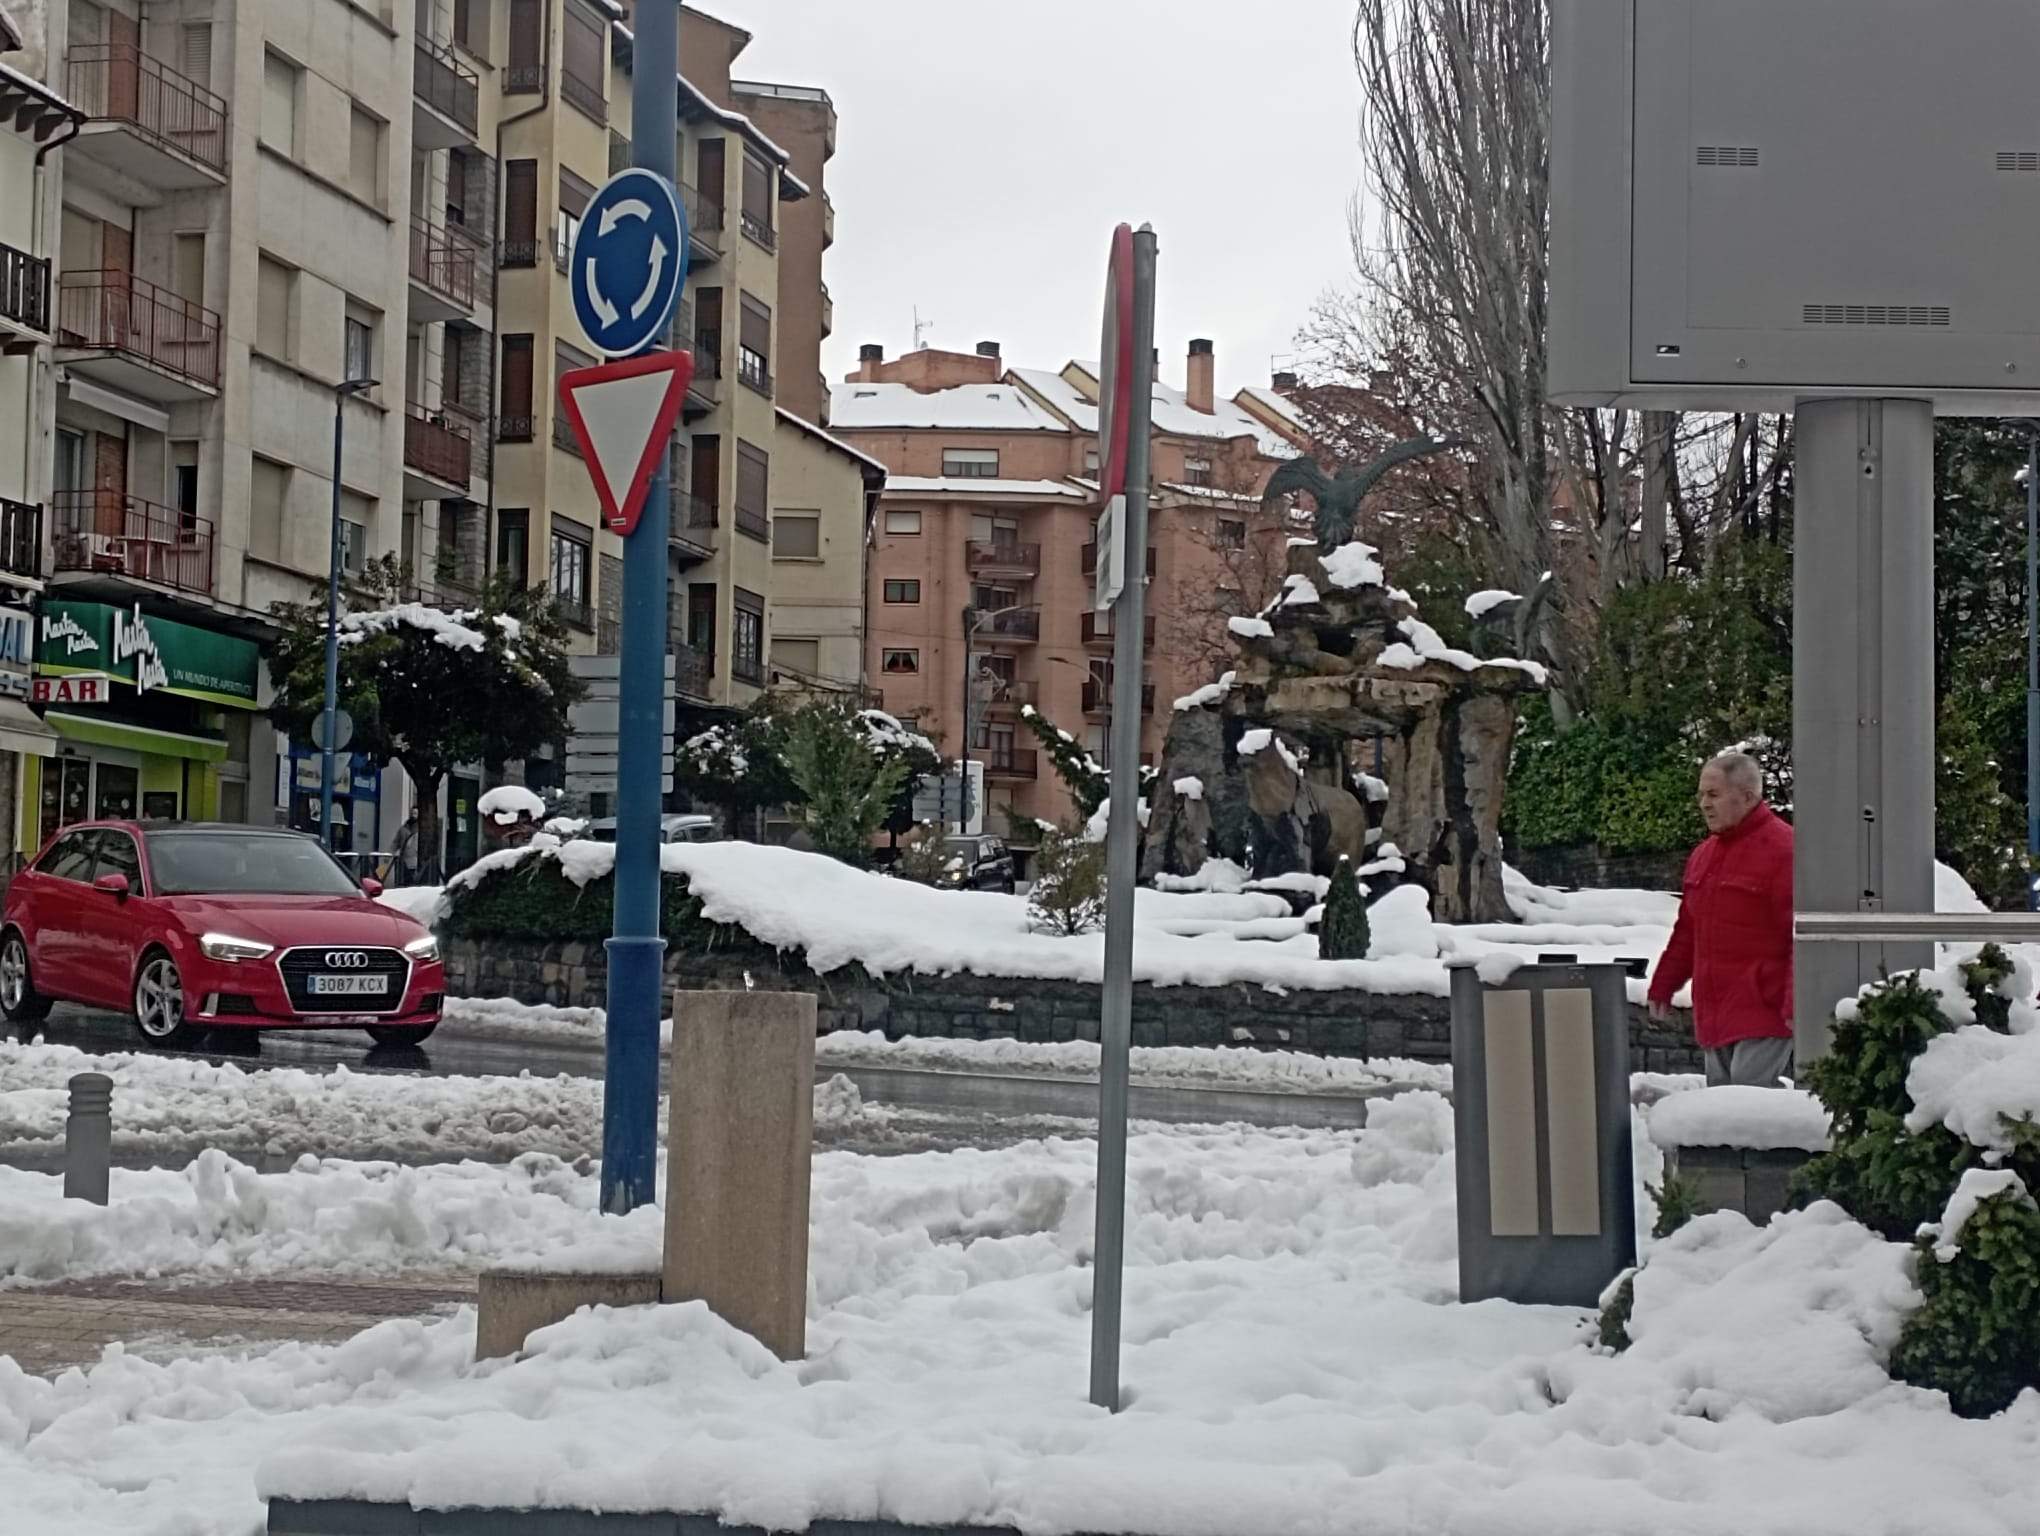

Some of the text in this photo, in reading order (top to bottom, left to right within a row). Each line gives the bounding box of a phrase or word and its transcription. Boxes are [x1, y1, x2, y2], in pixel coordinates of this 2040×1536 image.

[0, 613, 28, 665] AL
[184, 671, 210, 687] MUNDO
[33, 679, 97, 701] BAR
[318, 978, 384, 992] 3087 KCX
